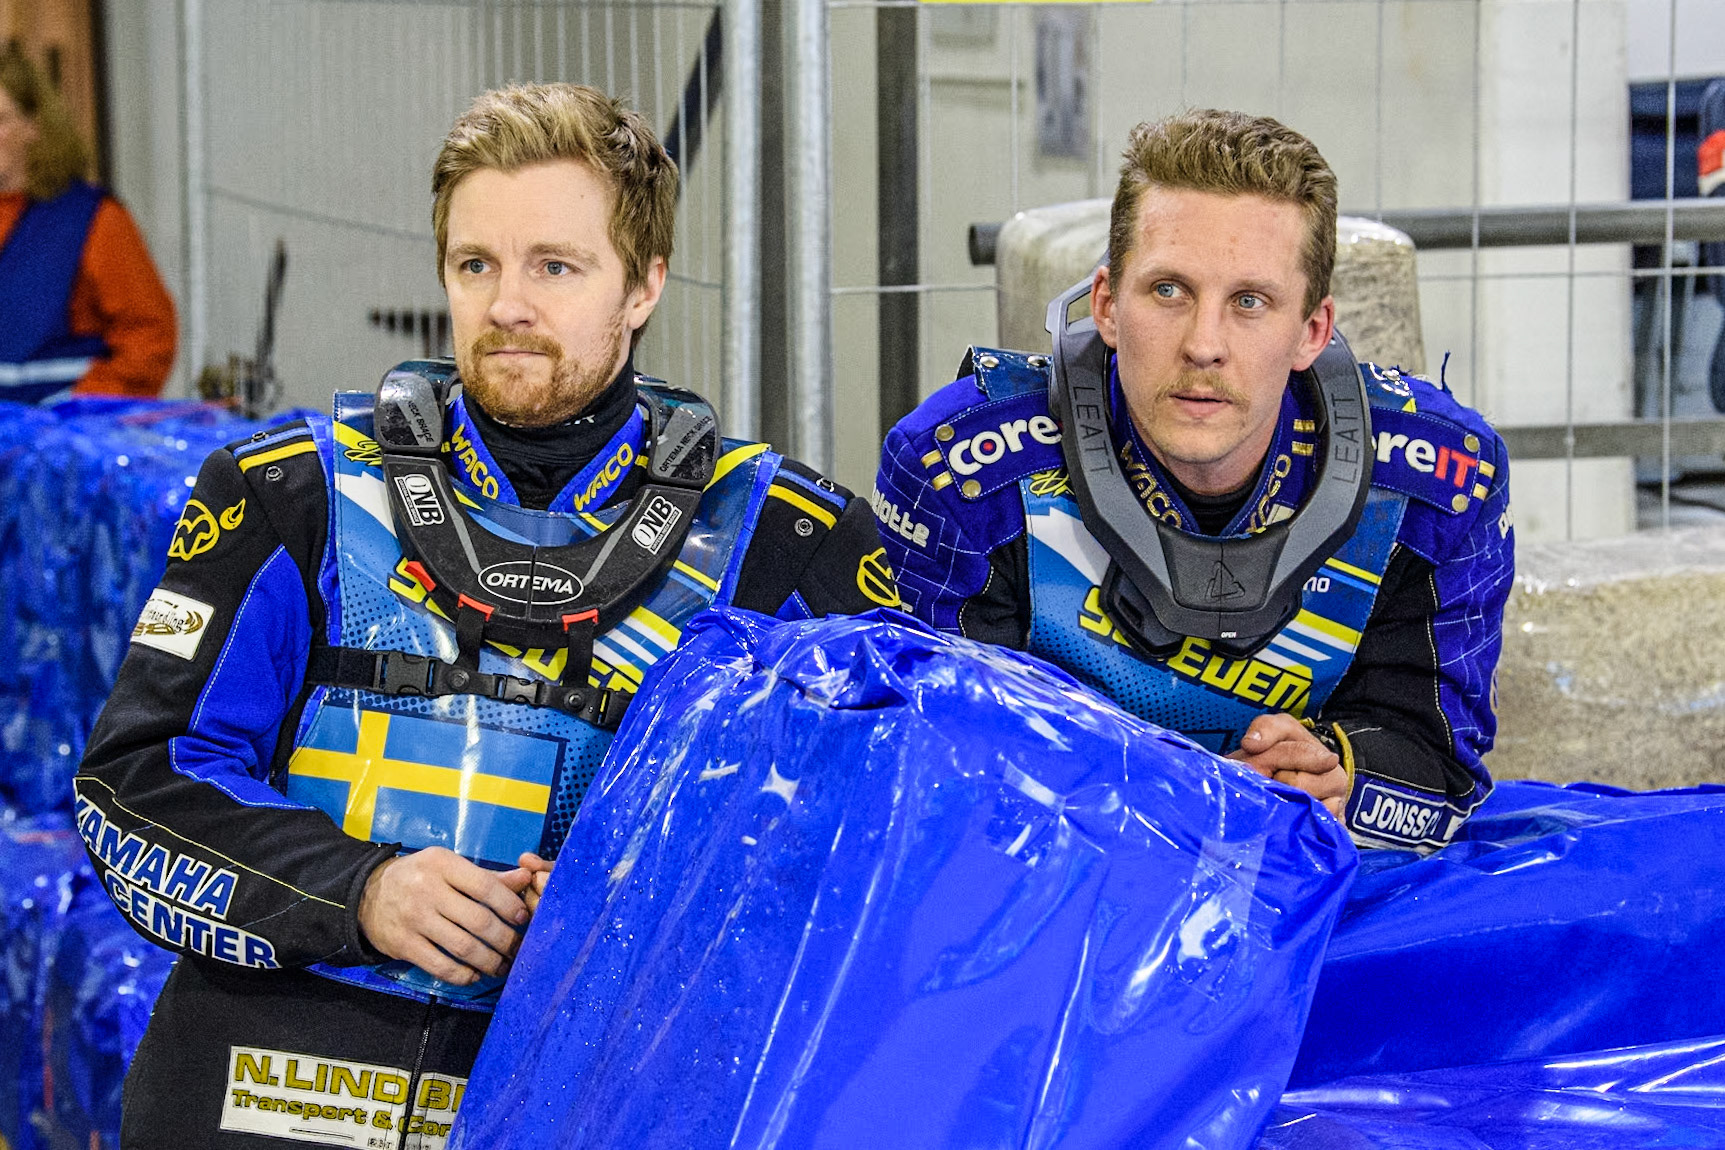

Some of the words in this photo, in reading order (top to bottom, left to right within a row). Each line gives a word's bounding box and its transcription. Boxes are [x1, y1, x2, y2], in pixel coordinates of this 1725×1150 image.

[659, 444, 684, 473] ORTEMA
[948, 415, 1063, 476] core
[1073, 386, 1114, 475] LEATT
[1331, 393, 1360, 484] LEATT
[1371, 431, 1478, 489] reIT
[450, 423, 500, 500] WACO
[573, 442, 634, 511] WACO
[405, 473, 445, 525] ONB
[632, 495, 674, 549] ONB
[485, 572, 574, 595] ORTEMA
[1078, 586, 1312, 709] SEDEN
[104, 868, 283, 969] CENTER
[231, 1089, 368, 1125] Transport
[372, 1110, 394, 1130] &
